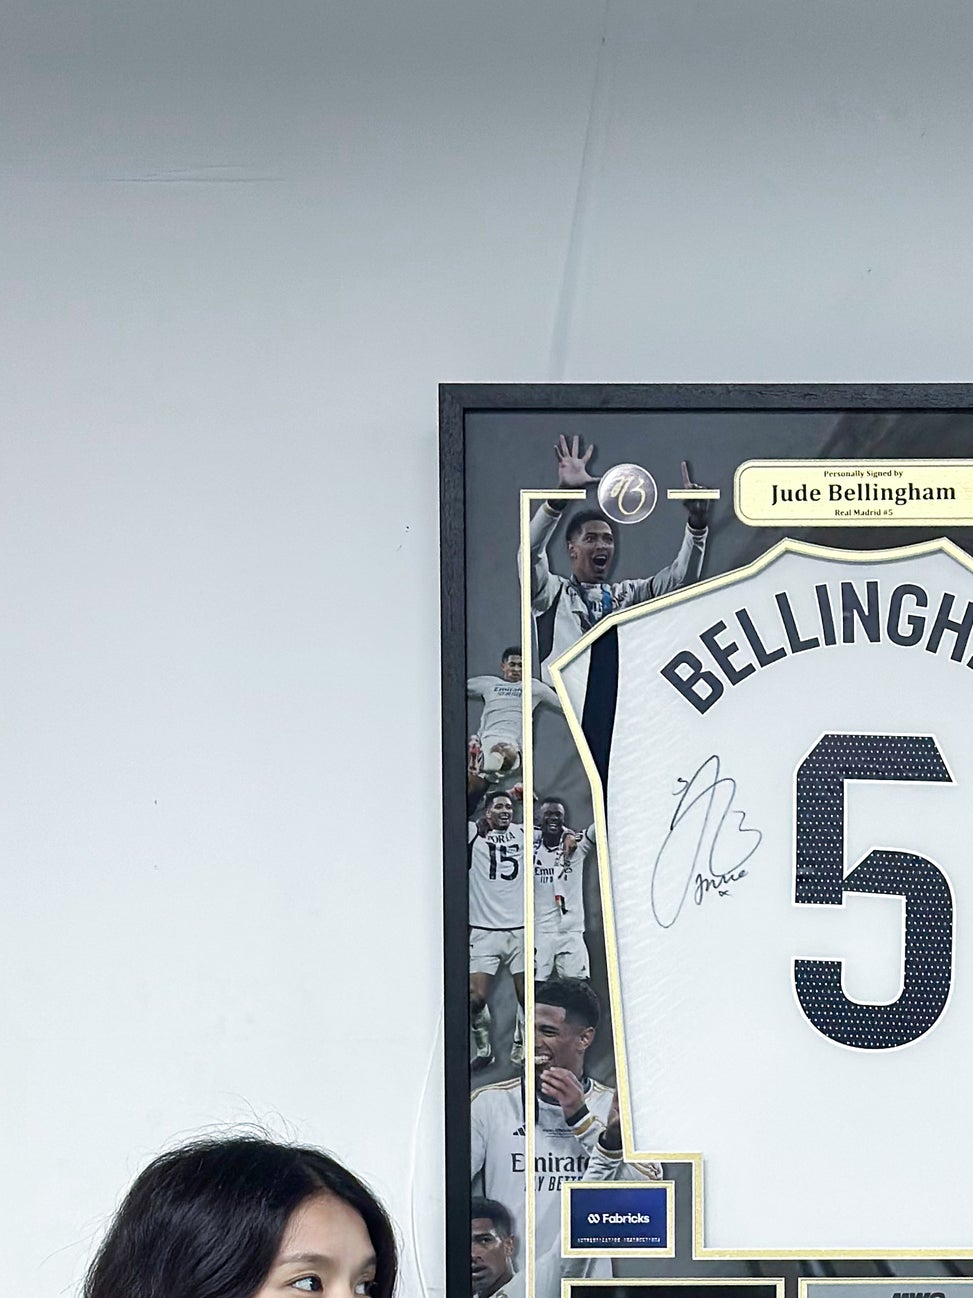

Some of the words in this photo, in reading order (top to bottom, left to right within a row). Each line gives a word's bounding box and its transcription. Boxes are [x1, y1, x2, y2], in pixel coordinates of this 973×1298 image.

[823, 470, 865, 478] Personally
[866, 469, 892, 478] Signed
[893, 469, 904, 478] by
[771, 483, 821, 506] Jude
[828, 482, 957, 506] Bellingham
[486, 841, 519, 881] 15
[790, 730, 959, 1054] 5
[602, 1212, 650, 1224] Fabricks
